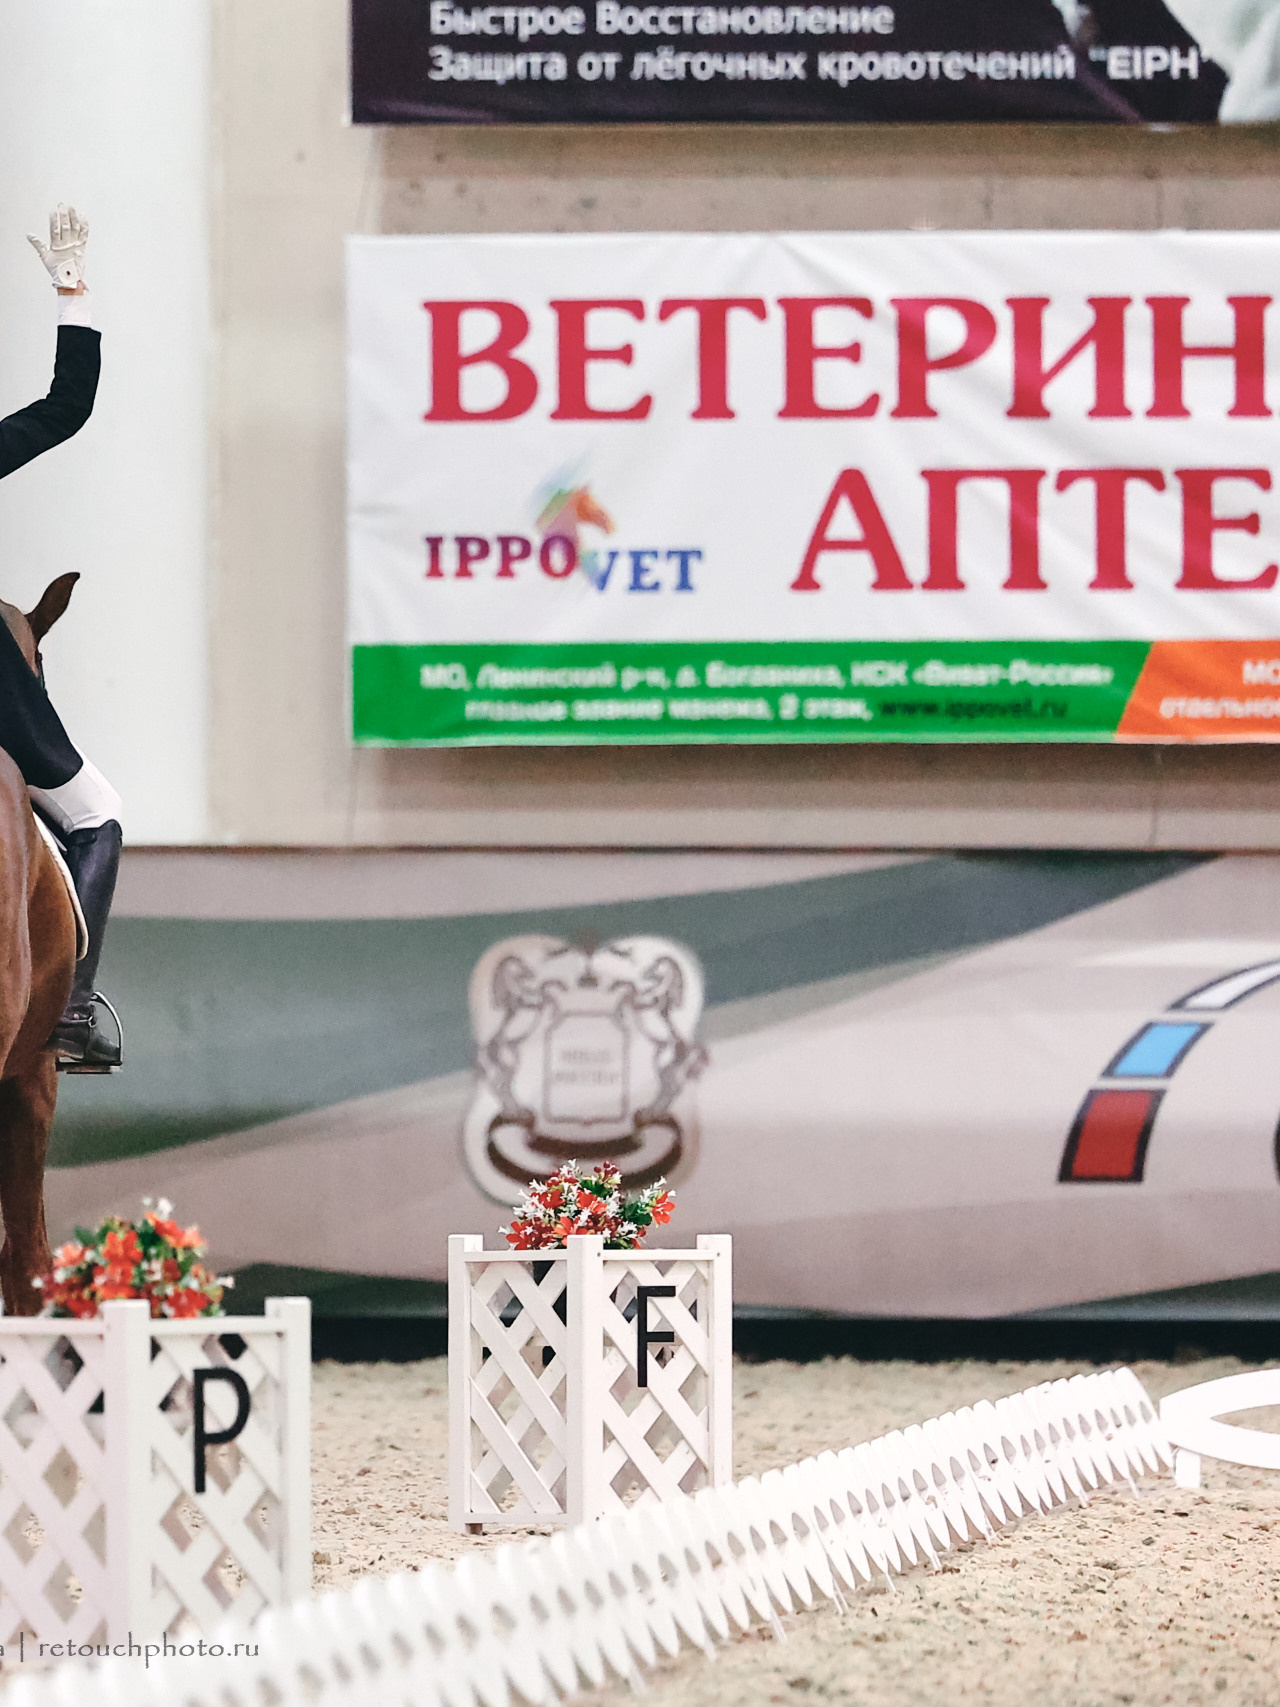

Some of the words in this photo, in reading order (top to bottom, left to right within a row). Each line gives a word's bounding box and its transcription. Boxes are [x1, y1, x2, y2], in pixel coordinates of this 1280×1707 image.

[427, 45, 568, 84] Защита
[576, 52, 622, 81] от
[630, 45, 807, 81] лёгочных
[817, 44, 1076, 87] кровотечений
[429, 0, 586, 41] Быстрое
[595, 0, 895, 35] Восстановление
[423, 295, 1280, 421] ВЕТЕРИН
[790, 468, 1279, 591] АПТЕ
[637, 1285, 676, 1388] F
[193, 1367, 251, 1493] P
